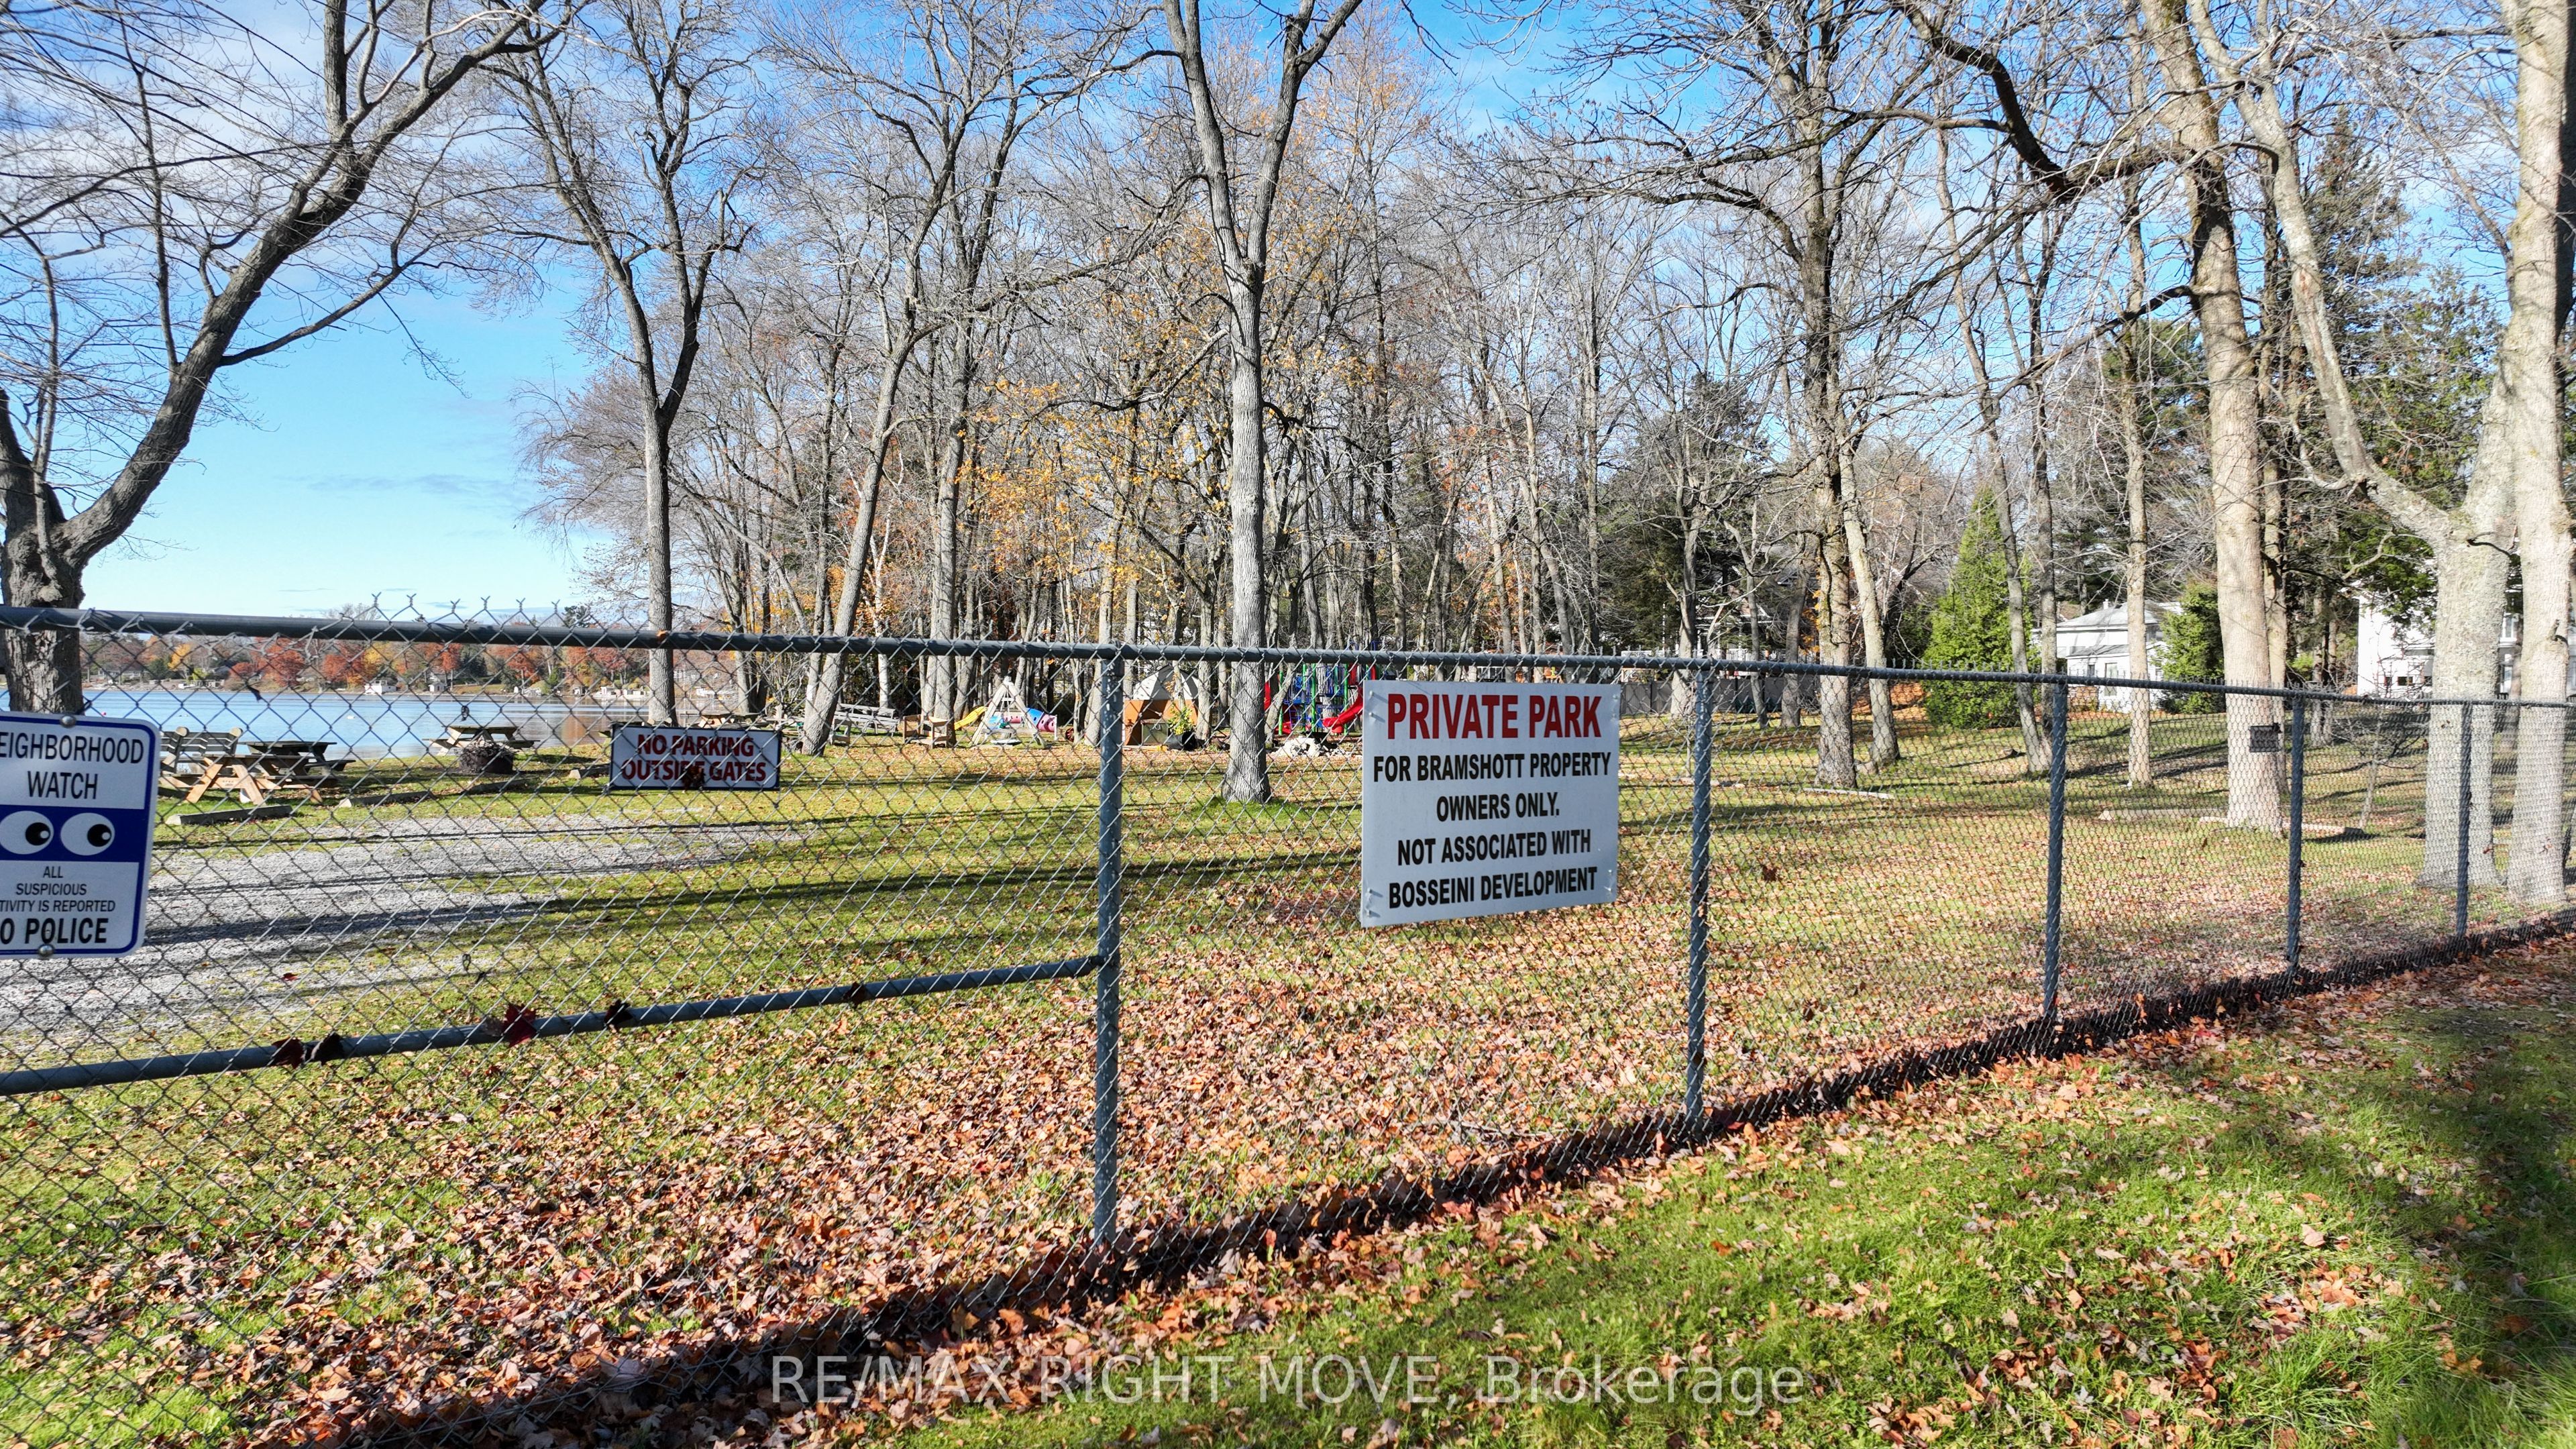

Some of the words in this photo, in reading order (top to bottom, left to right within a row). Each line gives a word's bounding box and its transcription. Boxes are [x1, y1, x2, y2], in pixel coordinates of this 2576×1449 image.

[1387, 693, 1519, 739] PRIVATE
[1529, 695, 1602, 737] PARK
[0, 732, 144, 764] EIGHBORHOOD
[637, 734, 667, 755] NO
[671, 736, 754, 757] PARKING
[621, 759, 705, 781] OUTSI
[709, 761, 767, 782] GATES
[1373, 755, 1411, 782] FOR
[1417, 753, 1525, 781] BRAMSHOTT
[1530, 752, 1611, 777] PROPERTY
[28, 771, 98, 799] WATCH
[1436, 794, 1510, 822] OWNERS
[1515, 792, 1560, 818] ONLY.
[1398, 839, 1436, 866] NOT
[1441, 832, 1547, 863] ASSOCIATED
[1551, 828, 1591, 855] WITH
[43, 866, 63, 878] ALL
[16, 883, 87, 896] SUSPICIOUS
[1389, 877, 1474, 909] BOSSEINI
[1481, 867, 1597, 900] DEVELOPMENT
[0, 900, 35, 912] TIVITY
[38, 900, 50, 912] IS
[53, 900, 115, 912] REPORTED
[0, 918, 15, 945] O
[25, 918, 109, 944] POLICE
